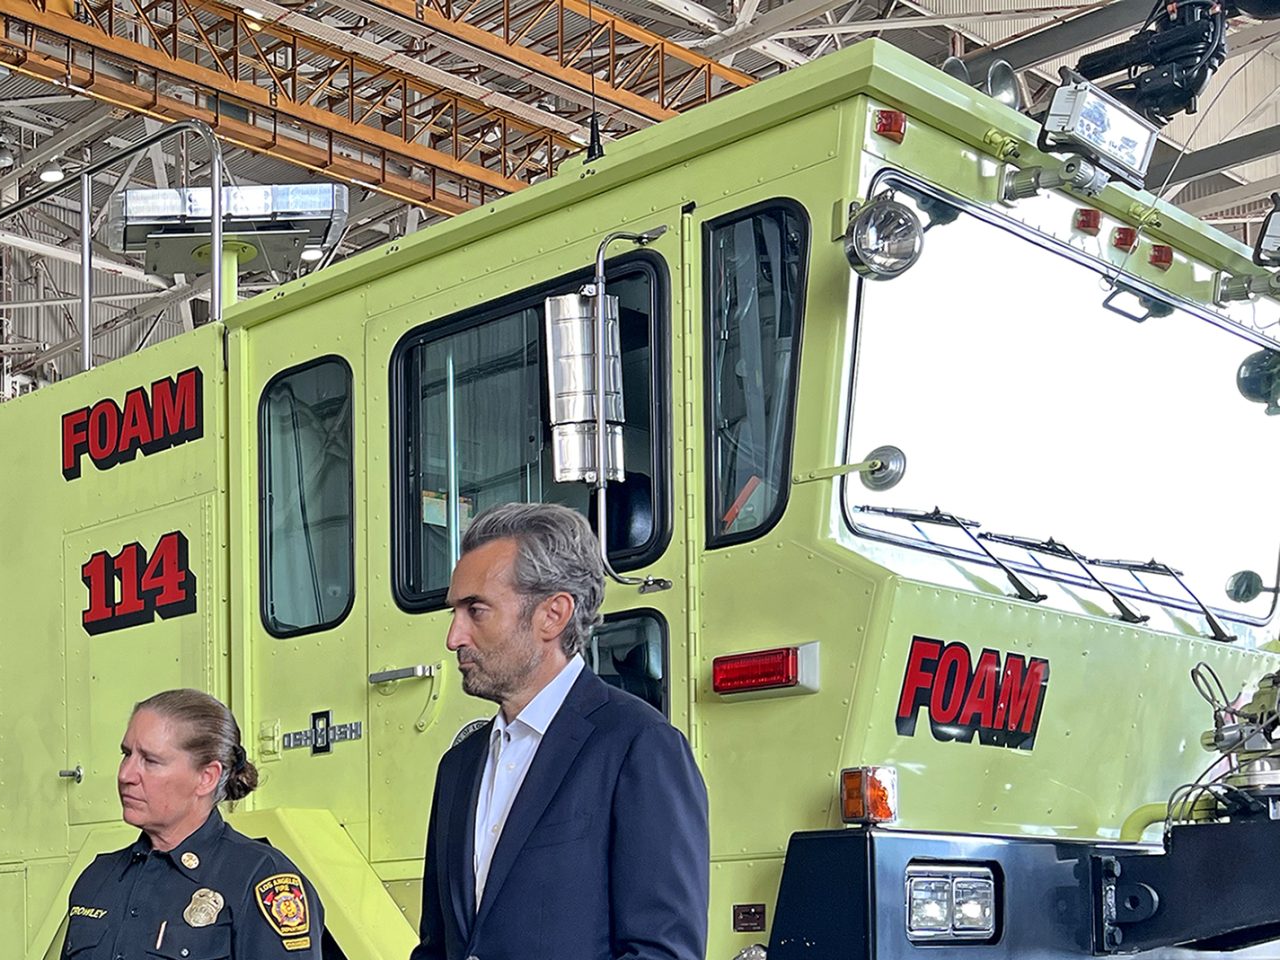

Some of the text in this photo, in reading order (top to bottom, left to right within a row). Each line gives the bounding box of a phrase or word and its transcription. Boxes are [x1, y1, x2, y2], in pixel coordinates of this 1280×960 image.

[62, 366, 203, 481] FOAM
[82, 530, 196, 636] 114
[895, 635, 1050, 751] FOAM
